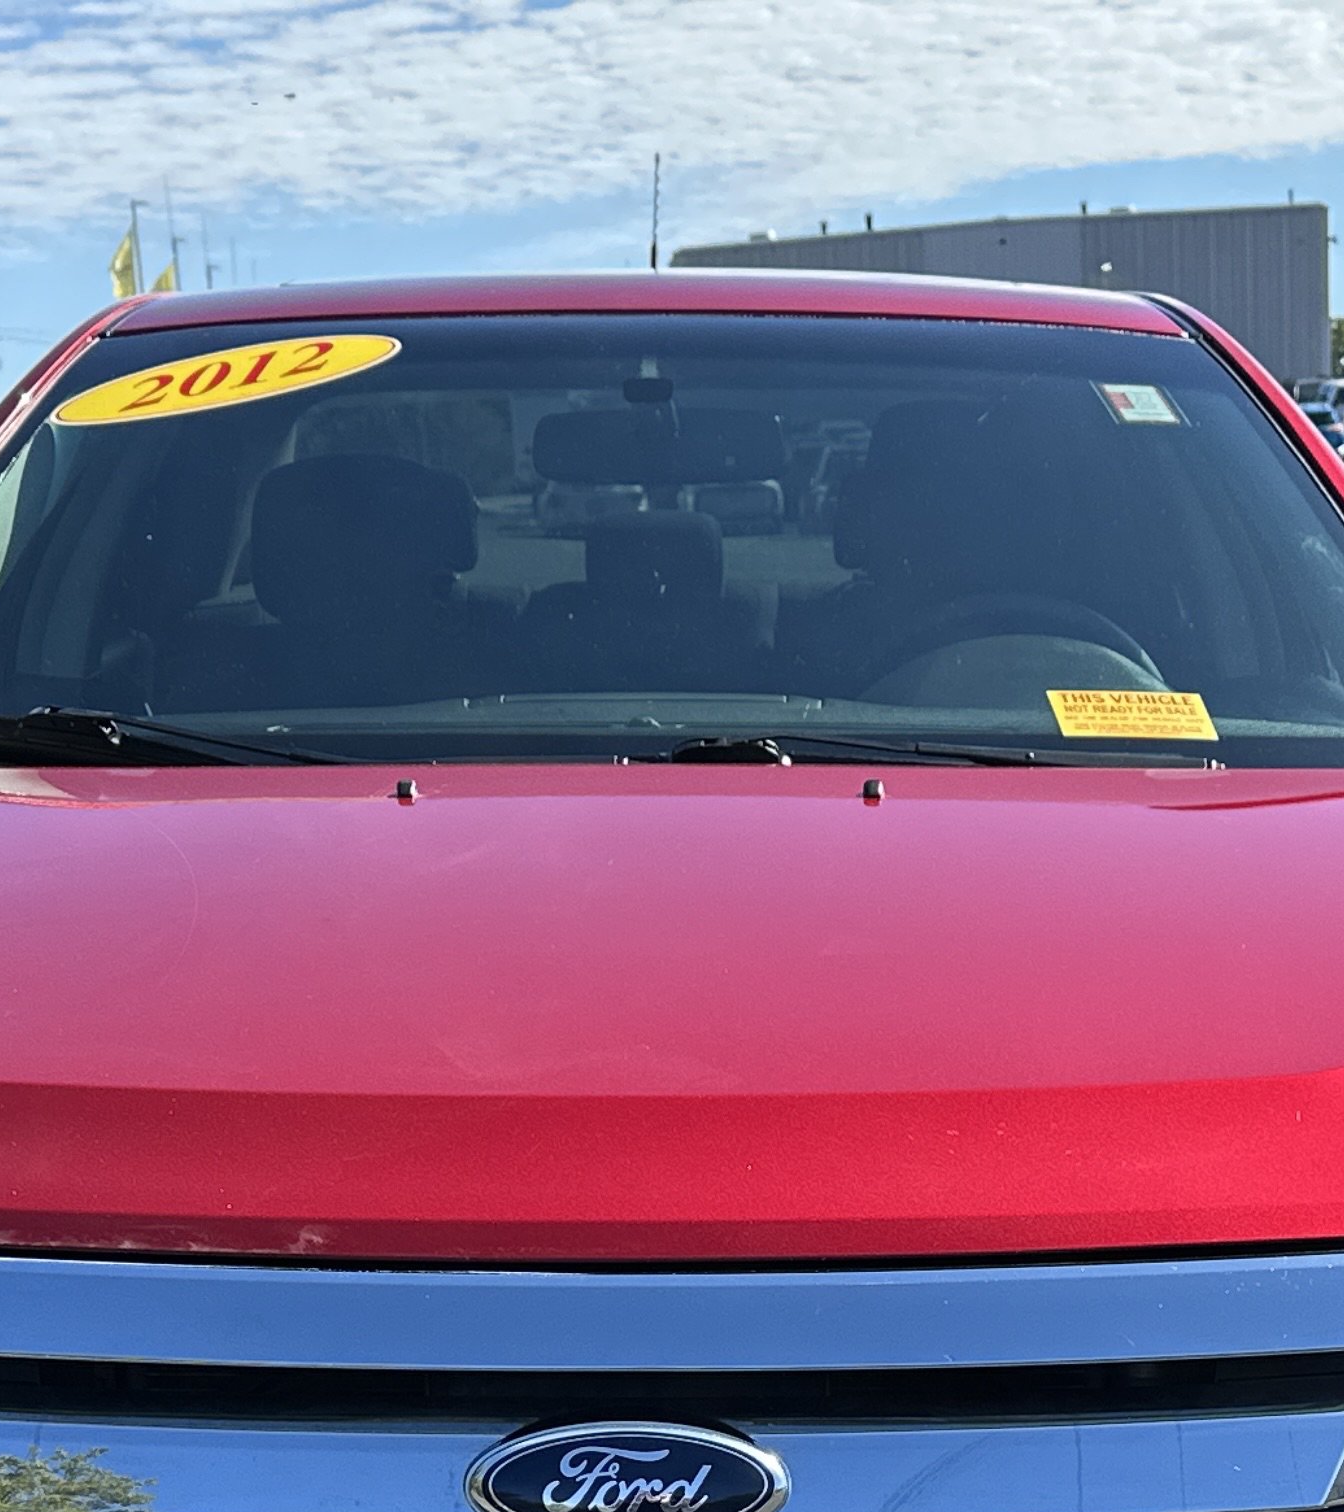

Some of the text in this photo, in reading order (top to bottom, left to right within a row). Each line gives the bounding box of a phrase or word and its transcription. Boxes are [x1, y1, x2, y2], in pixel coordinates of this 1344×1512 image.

[118, 342, 335, 413] 2012
[1058, 693, 1195, 706] THIS VEHICLE
[1064, 704, 1198, 716] NOT READY FOR SALE
